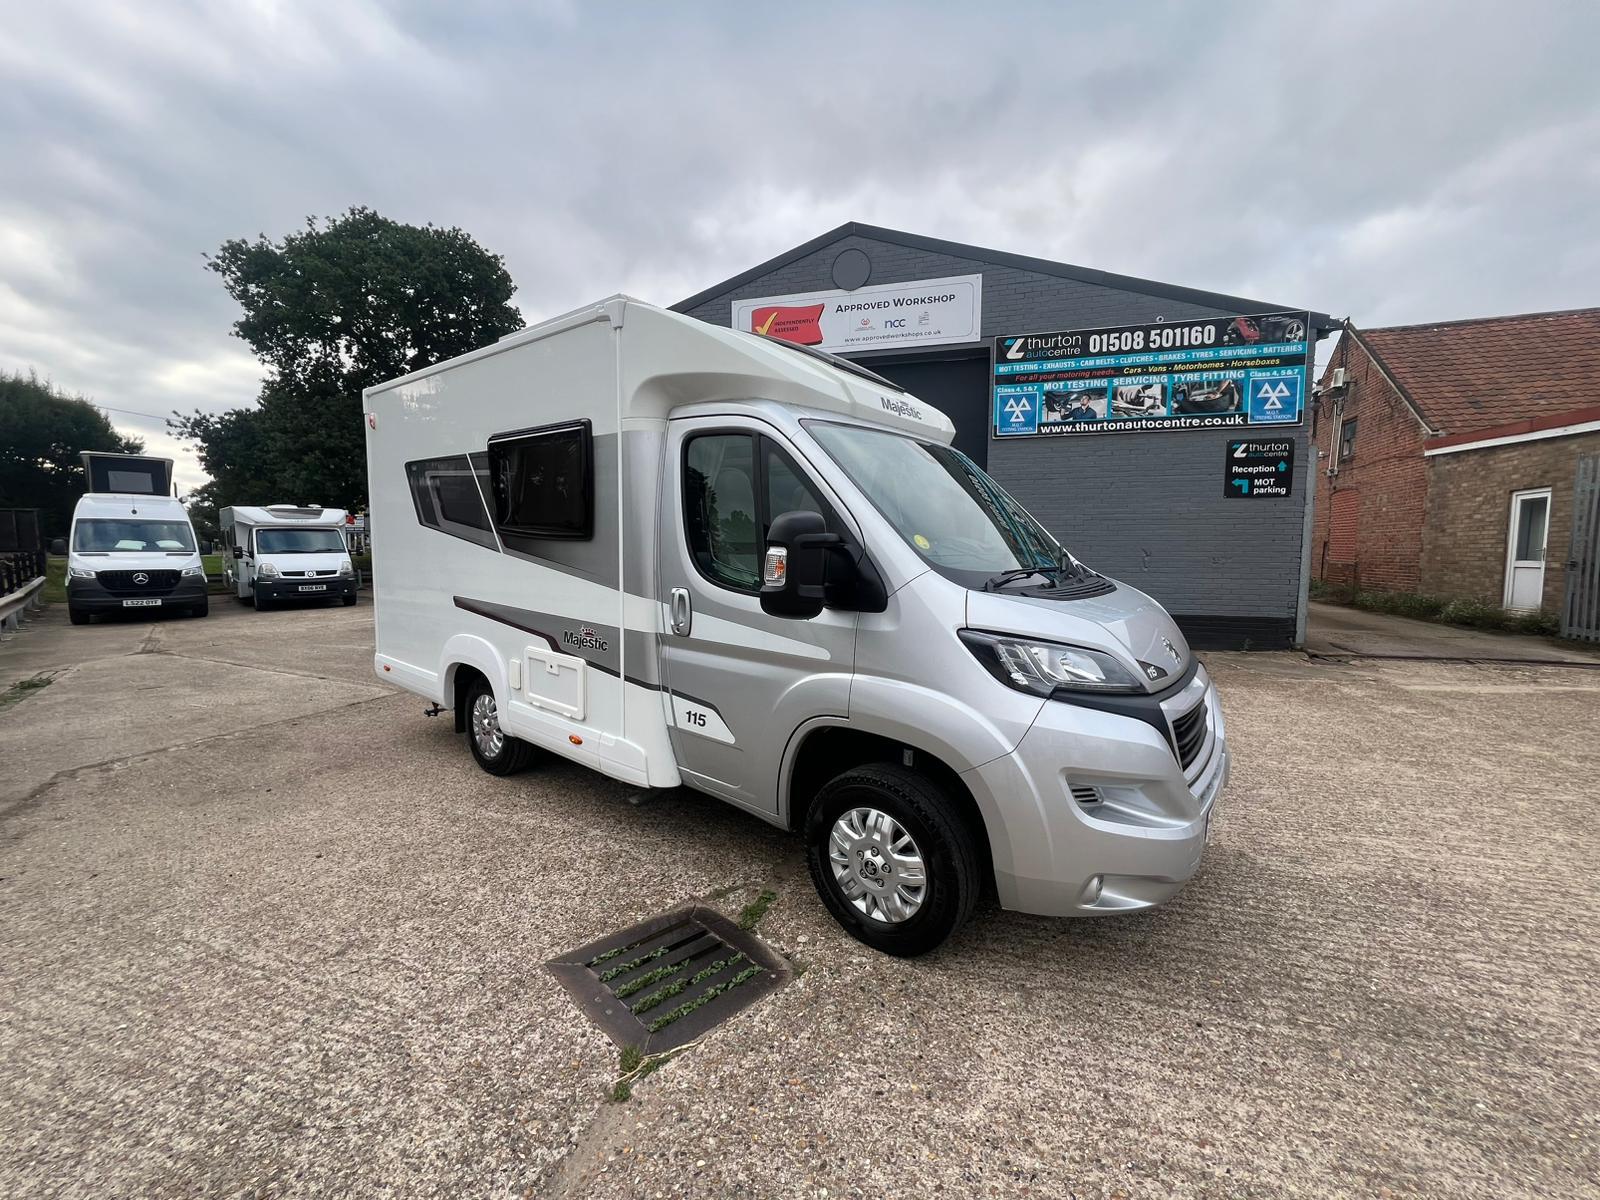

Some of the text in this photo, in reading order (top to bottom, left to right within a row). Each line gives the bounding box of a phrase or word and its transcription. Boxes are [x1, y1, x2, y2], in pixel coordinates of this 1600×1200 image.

[774, 317, 815, 326] INDEPENDENTLY
[884, 319, 906, 329] ncc
[1027, 335, 1082, 349] thurton
[1089, 324, 1217, 353] 01508 501160
[1013, 363, 1039, 372] TESTING
[1042, 361, 1076, 370] EXHAUSTS
[1080, 359, 1095, 367] CAM
[1095, 357, 1115, 366] BELTS
[1119, 354, 1154, 364] CLUTCHES
[1158, 351, 1186, 361] BRAKES
[1191, 350, 1214, 359] TYRES
[1219, 347, 1258, 357] SERVICING
[1263, 344, 1303, 354] BATTERIES
[1026, 347, 1081, 359] autocentre
[1015, 374, 1028, 382] For
[1028, 373, 1038, 381] all
[1039, 372, 1055, 383] your
[1056, 368, 1090, 380] motoring
[1123, 366, 1142, 375] Cars
[1147, 363, 1168, 373] Vans
[1172, 360, 1225, 372] Motorhomes
[1230, 357, 1281, 368] Horseboxes
[1173, 369, 1246, 383] TYRE FITTING
[1249, 369, 1271, 378] Class
[1043, 378, 1108, 391] MOT TESTING
[1112, 374, 1168, 387] SERVICING
[997, 385, 1015, 393] Class
[880, 397, 922, 420] Majestic
[1040, 415, 1244, 433] www.thurtonautocentre.co.uk
[1249, 443, 1289, 451] thurton
[1232, 465, 1276, 474] Reception
[1253, 486, 1287, 495] parking
[563, 630, 608, 651] Majestic
[685, 710, 707, 727] 115
